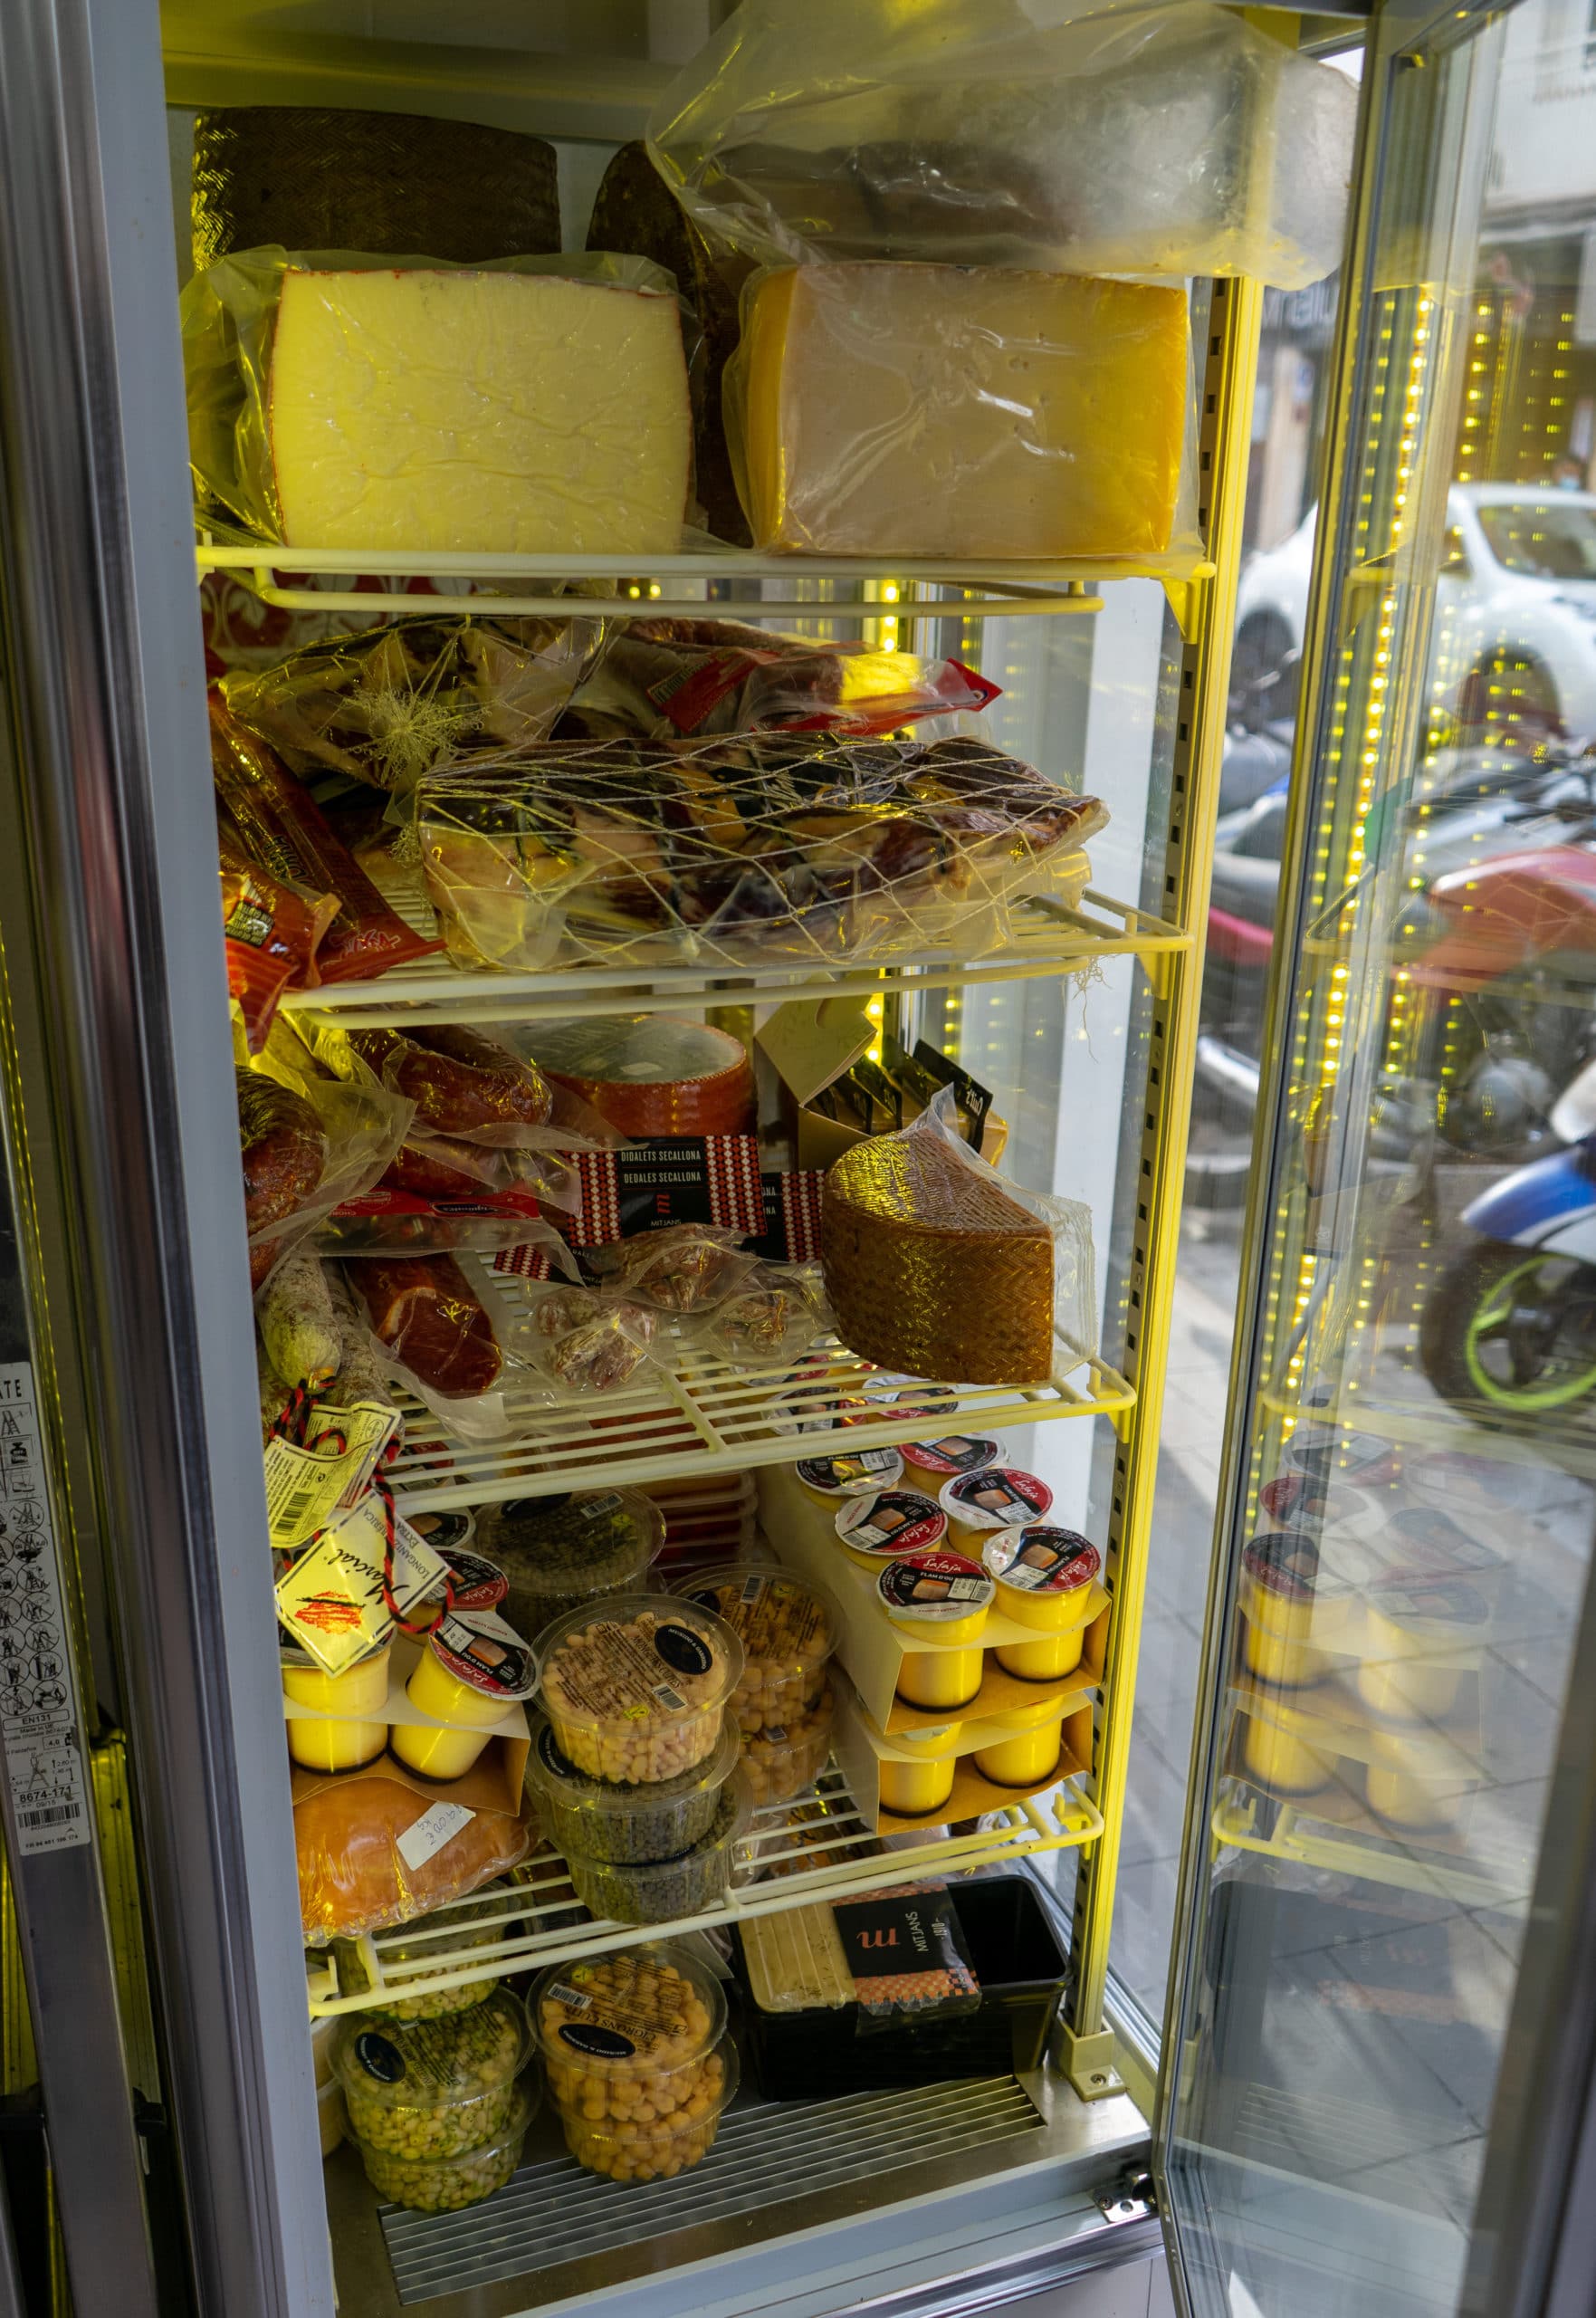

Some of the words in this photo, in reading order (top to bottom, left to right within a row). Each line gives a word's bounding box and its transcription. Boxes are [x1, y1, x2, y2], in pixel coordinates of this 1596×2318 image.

[621, 1152, 657, 1163] DIDALETS
[659, 1150, 701, 1162] SECALLONA
[624, 1173, 657, 1184] DEDALES
[659, 1172, 702, 1183] SECALLONA
[0, 1379, 22, 1399] TE
[393, 1538, 431, 1579] LONGANIZ
[328, 1548, 409, 1604] Marcial
[22, 1714, 51, 1725] EN131
[20, 1785, 72, 1803] 8674-171
[36, 1800, 56, 1809] 09/15
[906, 1911, 929, 1952] MITJANS
[601, 2019, 656, 2042] CIGRONS
